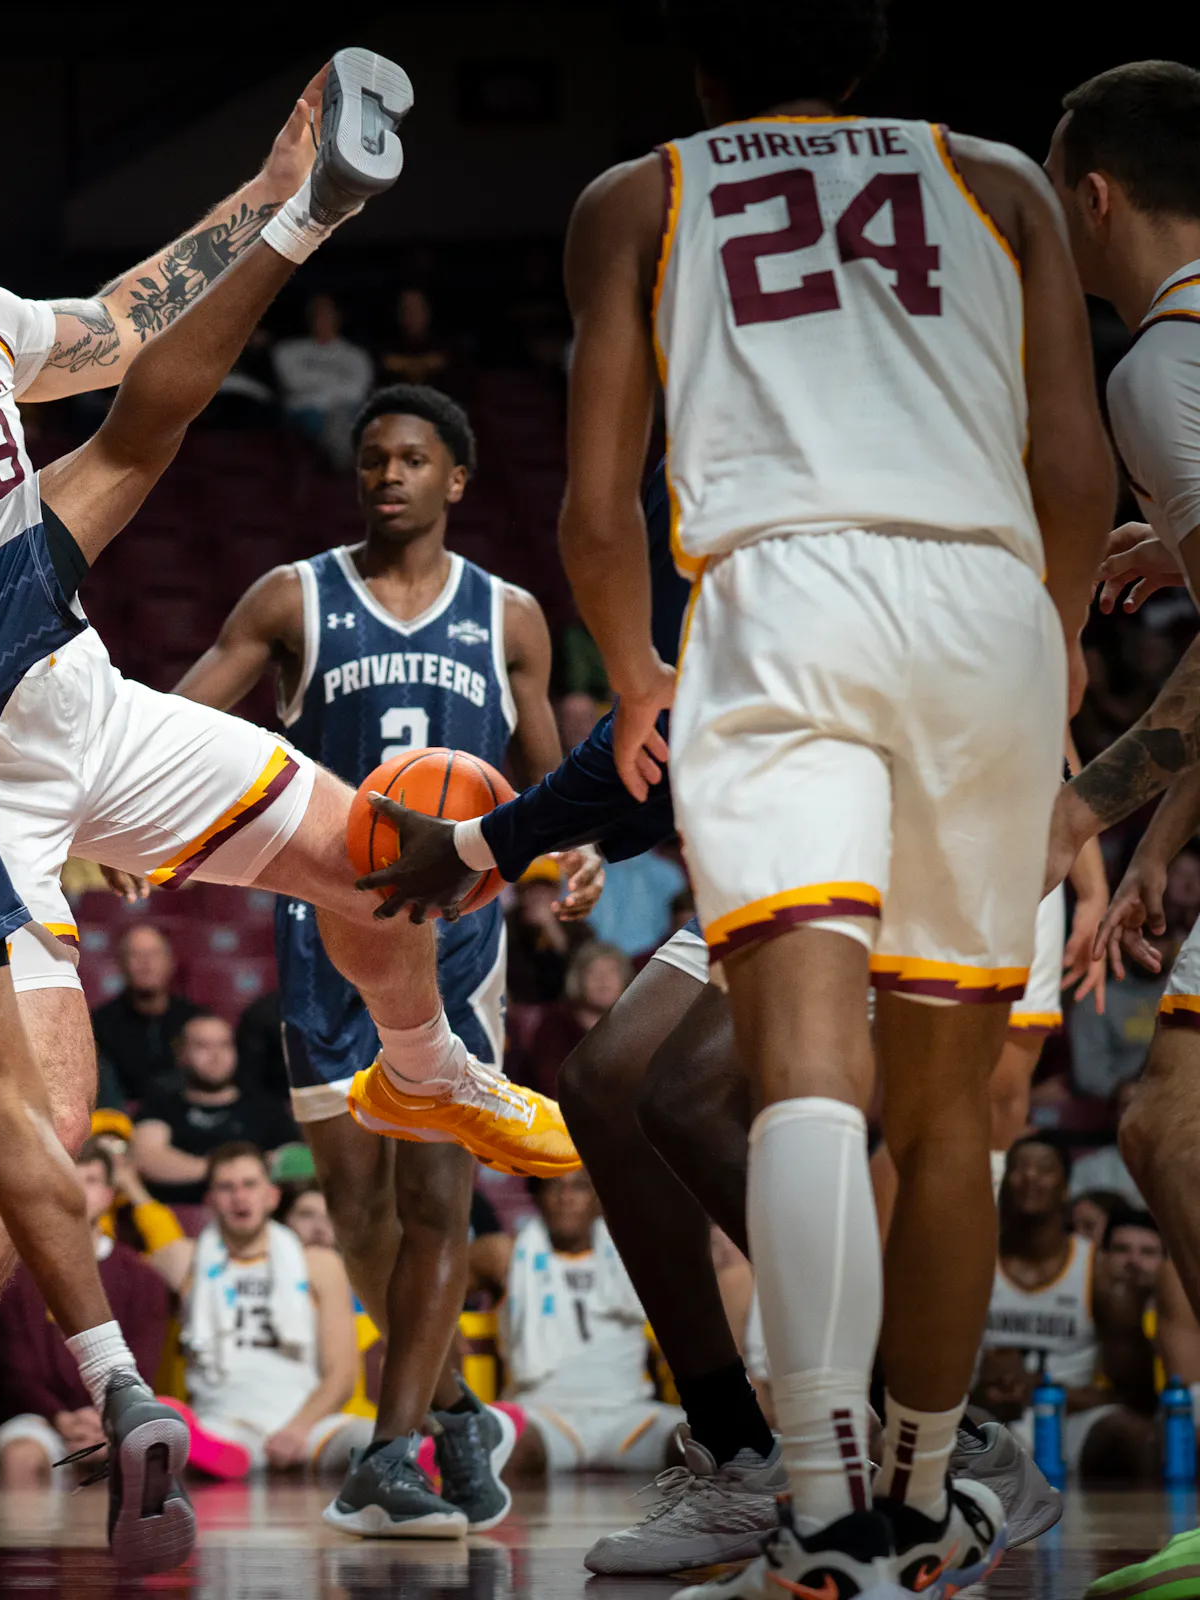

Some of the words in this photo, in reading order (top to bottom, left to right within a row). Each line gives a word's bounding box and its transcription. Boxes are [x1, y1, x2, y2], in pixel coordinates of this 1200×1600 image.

[707, 126, 909, 165] CHRISTIE
[710, 167, 943, 327] 24
[323, 652, 487, 707] PRIVATEERS
[380, 706, 430, 765] 2
